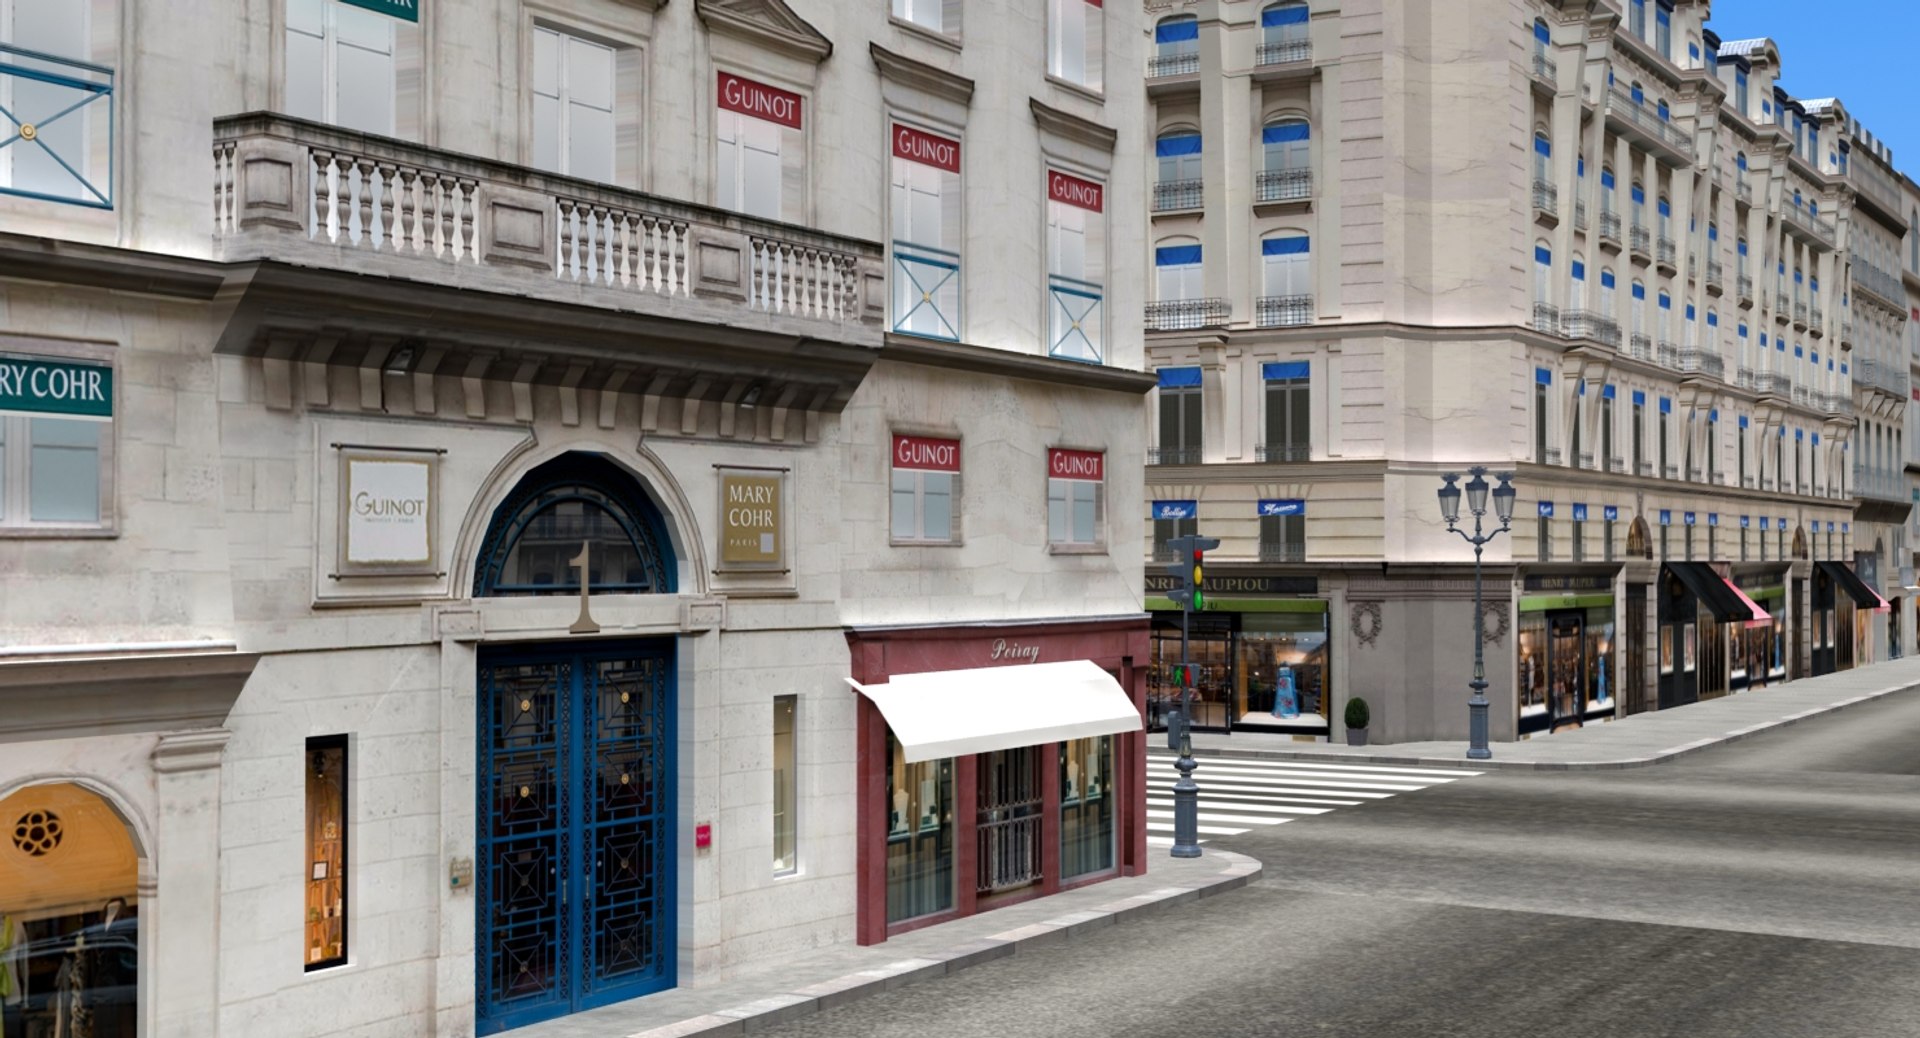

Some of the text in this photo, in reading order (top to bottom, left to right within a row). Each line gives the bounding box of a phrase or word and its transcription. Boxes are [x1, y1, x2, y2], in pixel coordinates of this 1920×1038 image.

[725, 79, 795, 120] GUINOT
[898, 130, 954, 166] GUINOT
[1053, 175, 1099, 206] GUINOT
[898, 439, 955, 465] GUINOT
[1053, 452, 1099, 475] GUINOT
[355, 491, 424, 516] GUINOT
[729, 484, 774, 504] MARY
[729, 508, 774, 527] COHR
[569, 540, 600, 634] 1
[991, 638, 1039, 663] Poiray
